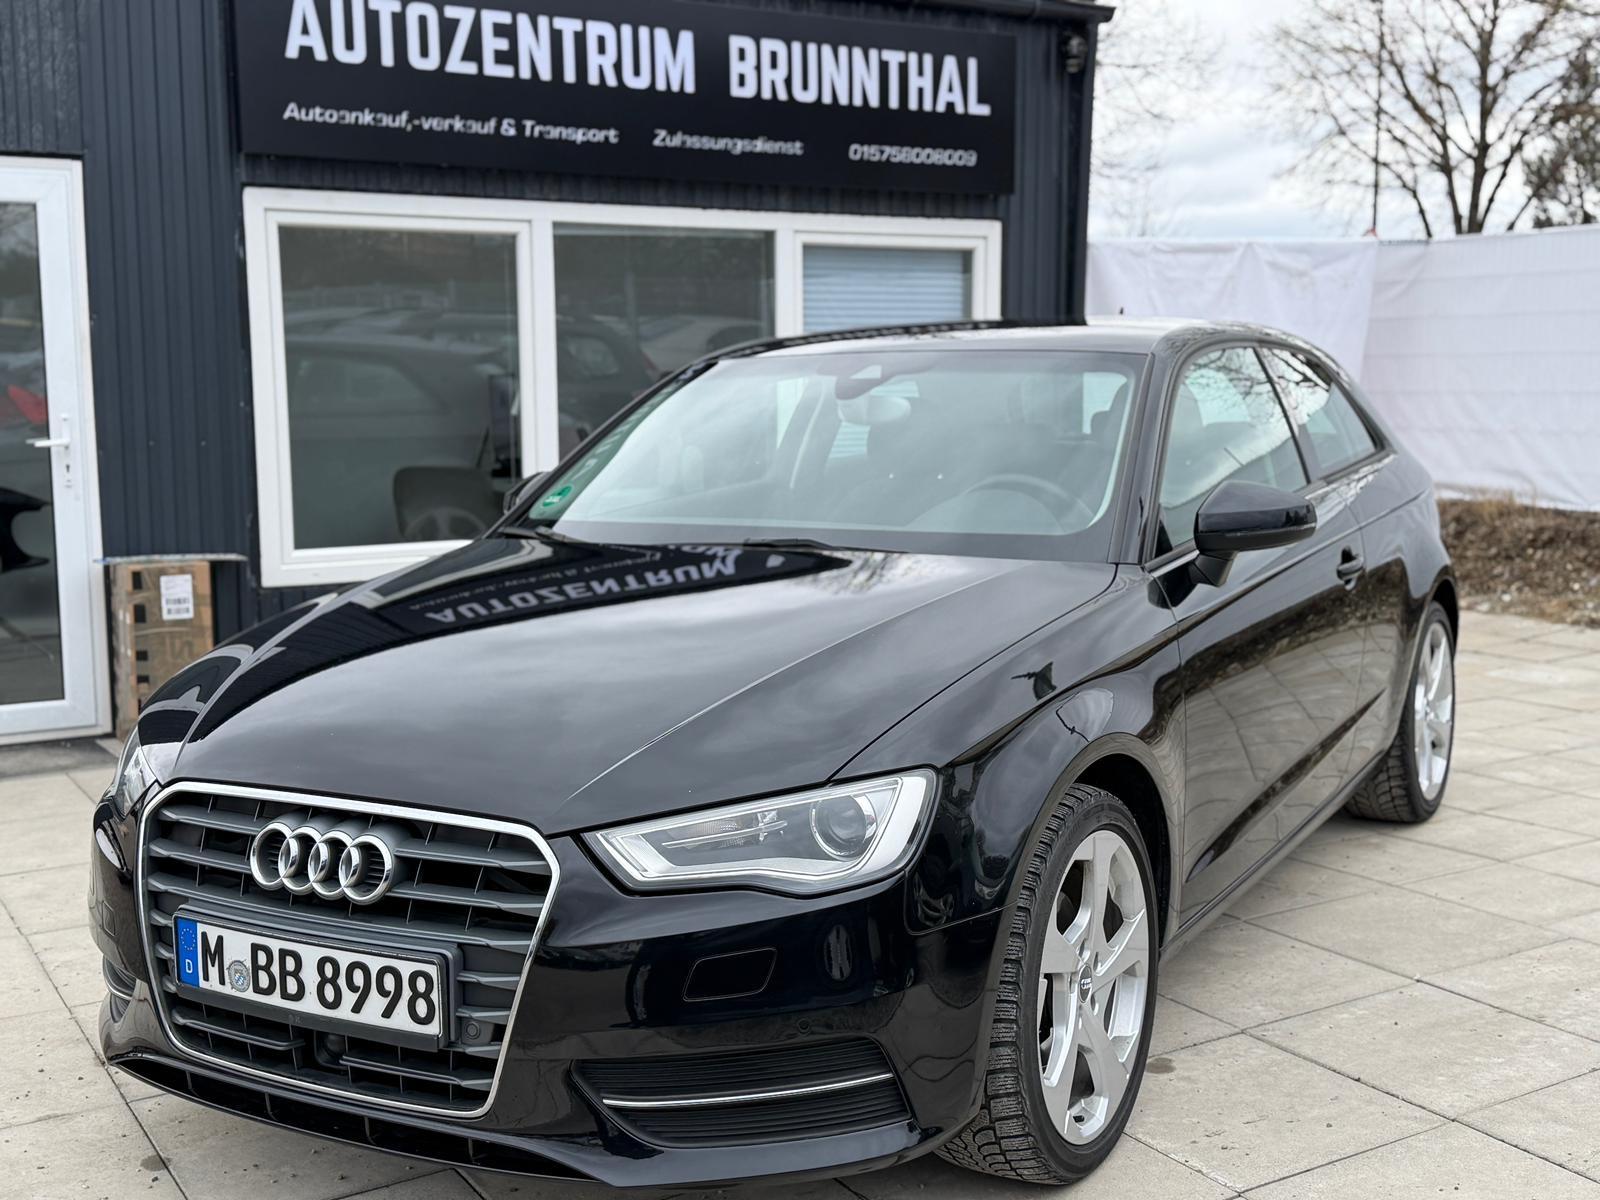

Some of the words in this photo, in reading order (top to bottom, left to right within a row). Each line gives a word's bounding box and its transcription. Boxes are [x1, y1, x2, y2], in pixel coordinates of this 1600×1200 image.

[284, 0, 696, 94] AUTOZENTRUM
[728, 34, 991, 116] BRUNNTHAL
[500, 118, 516, 136] &
[522, 119, 620, 145] Transport
[652, 128, 805, 155] Zulassungsdienst
[185, 958, 193, 973] D
[200, 931, 226, 986] M
[250, 942, 306, 1002] BB
[316, 955, 436, 1026] 8998
